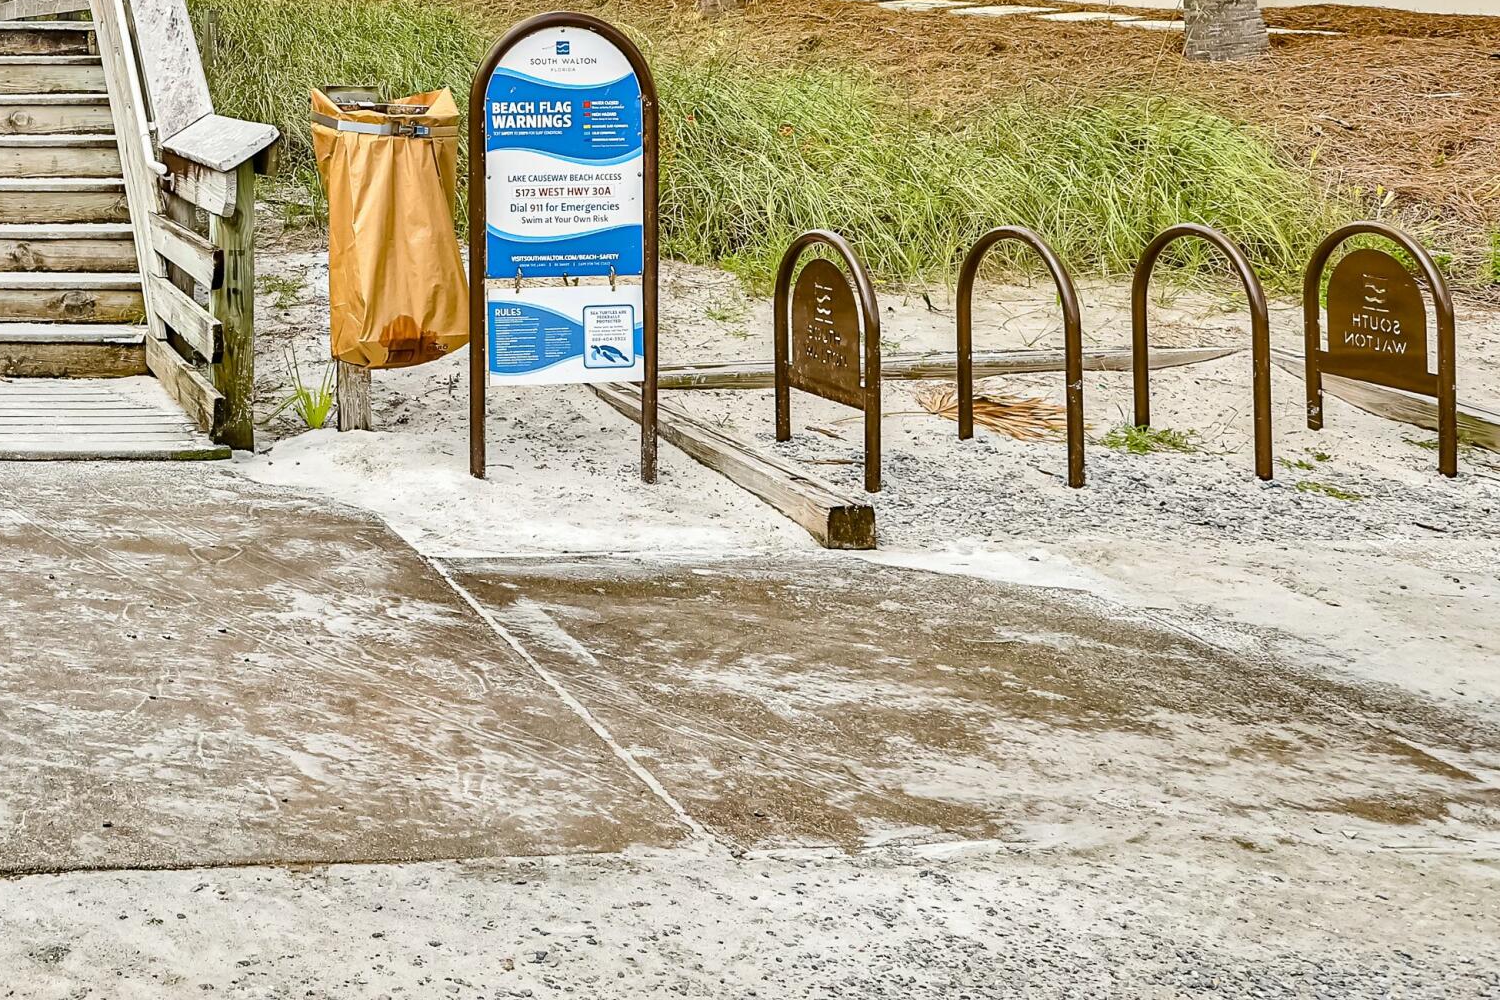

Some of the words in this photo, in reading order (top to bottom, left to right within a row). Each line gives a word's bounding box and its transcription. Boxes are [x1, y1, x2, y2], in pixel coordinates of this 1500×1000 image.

[529, 58, 558, 66] SOUTH
[561, 57, 597, 65] WALTON
[491, 102, 535, 114] BEACH
[539, 101, 572, 113] FLAG
[491, 114, 572, 129] WARNINGS
[507, 175, 526, 183] LAKE
[527, 174, 568, 182] CAUSEWAY
[569, 173, 593, 181] BEACH
[595, 173, 622, 181] ACCESS
[515, 188, 536, 197] 5173
[538, 187, 565, 197] WEST
[567, 187, 590, 196] HWY
[592, 186, 611, 195] 30A
[510, 203, 527, 213] Dial
[530, 203, 543, 212] 911
[546, 202, 558, 212] for
[561, 201, 620, 213] Emergencies
[521, 216, 543, 224] Swim
[554, 215, 572, 223] Your
[573, 215, 591, 223] Own
[593, 214, 609, 222] Risk
[511, 253, 619, 262] VISITSOUTHWALTON.COM/BEACH-SAFETY
[494, 308, 522, 317] RULES
